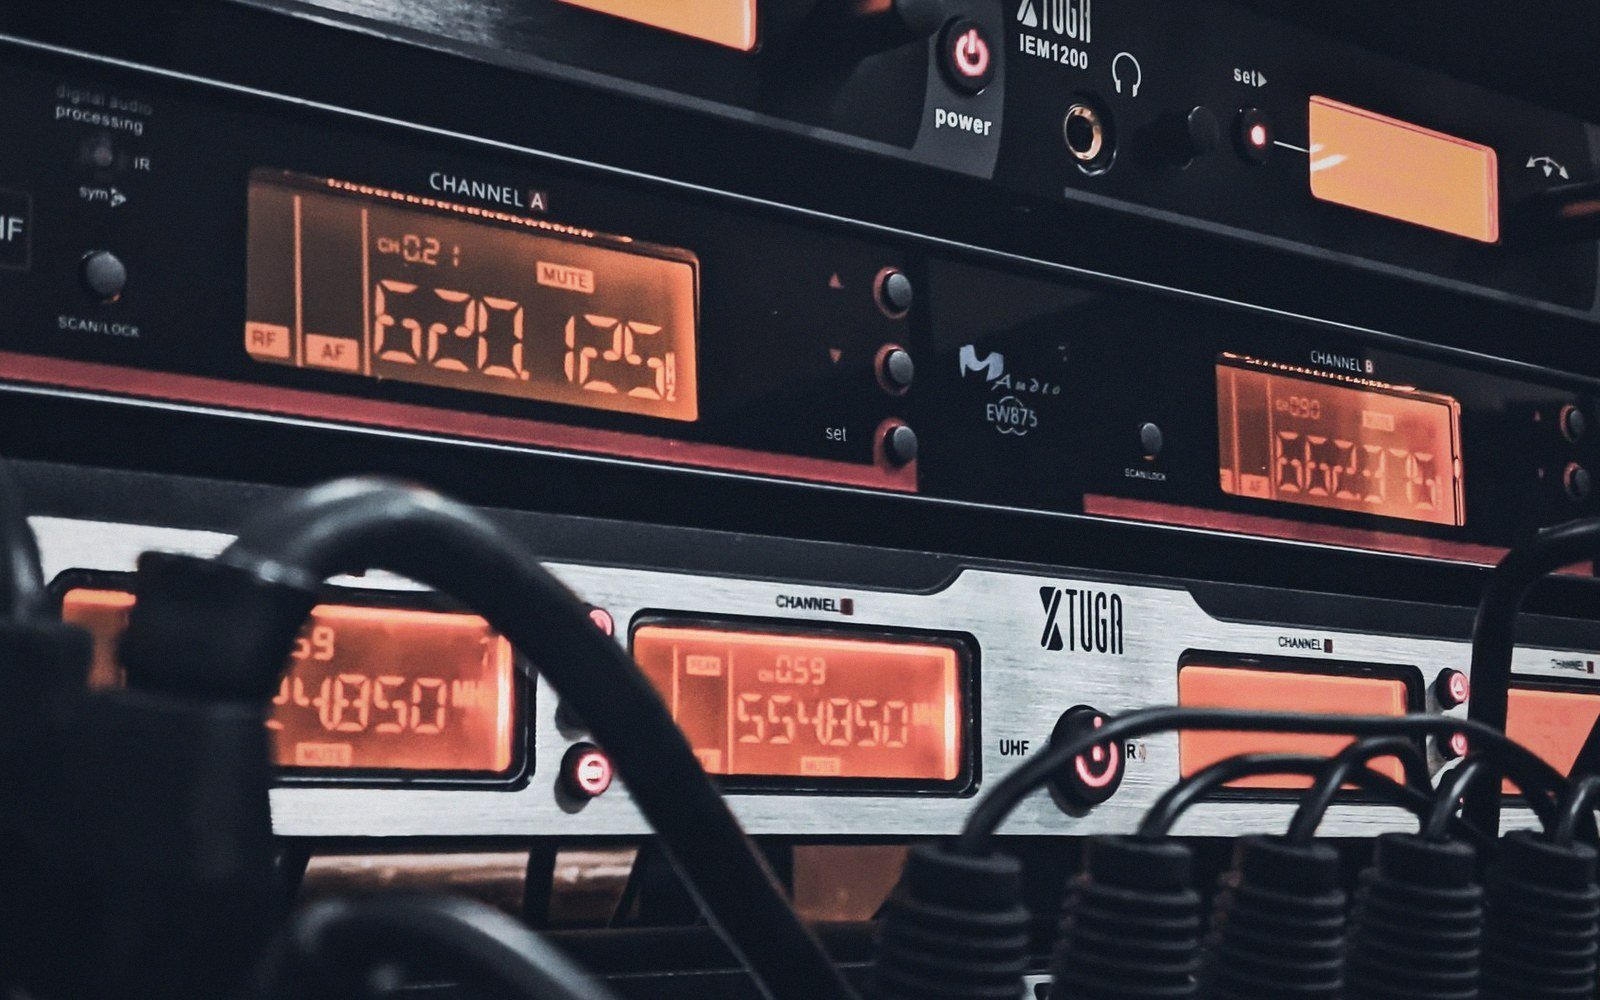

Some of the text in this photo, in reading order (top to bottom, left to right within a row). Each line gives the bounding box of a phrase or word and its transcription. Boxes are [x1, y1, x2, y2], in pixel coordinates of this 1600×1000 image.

[1019, 33, 1088, 70] IEM1200
[1233, 67, 1257, 87] set
[55, 105, 144, 136] processing
[935, 108, 992, 136] power
[134, 157, 151, 171] IR
[429, 171, 546, 211] CHANNEL A
[541, 266, 589, 290] MUTE
[58, 316, 140, 338] SCAN/LOCK
[250, 329, 277, 350] RF
[320, 344, 346, 361] AF
[1310, 350, 1374, 374] CHANNEL B
[986, 403, 1038, 428] EW875
[776, 594, 840, 612] CHANNEL
[1278, 635, 1323, 651] CHANNEL
[1000, 740, 1030, 756] UHF
